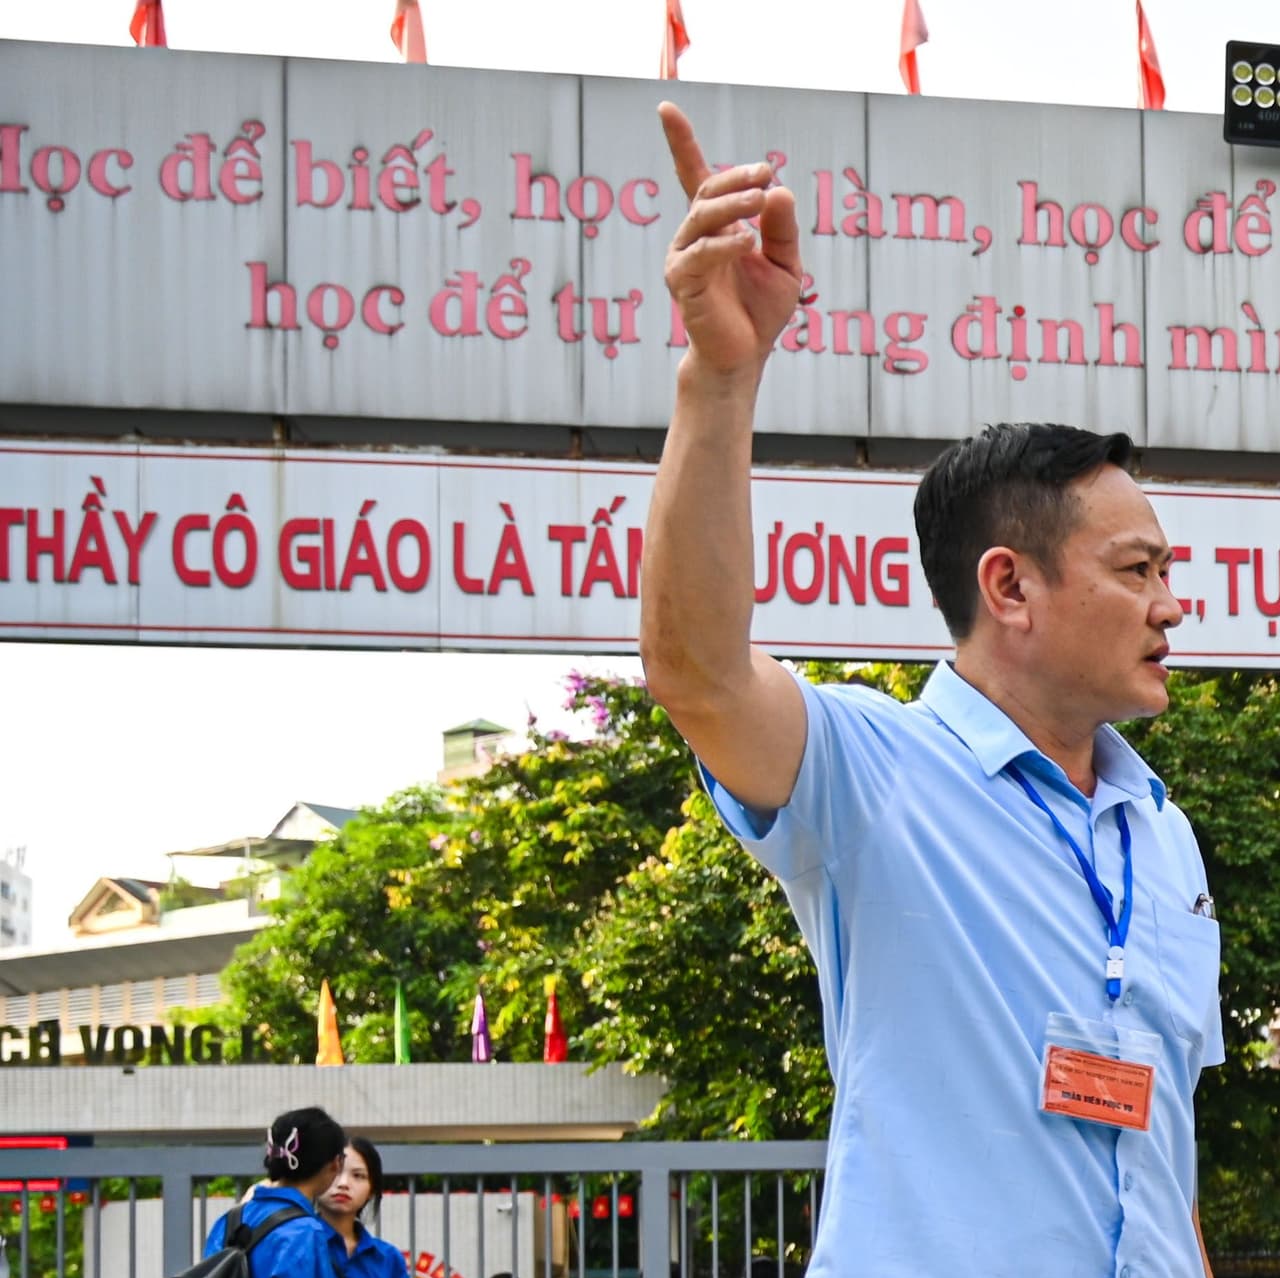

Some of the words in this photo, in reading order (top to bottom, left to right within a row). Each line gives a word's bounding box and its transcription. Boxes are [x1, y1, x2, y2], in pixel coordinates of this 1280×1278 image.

[160, 120, 265, 204] để
[292, 128, 482, 228] biết,
[511, 152, 660, 239] học
[813, 166, 993, 254] làm,
[1017, 180, 1159, 266] học
[1183, 179, 1278, 258] để
[246, 260, 405, 350] học
[428, 258, 533, 340] để
[553, 282, 644, 360] tự
[951, 294, 1145, 381] định
[0, 475, 159, 586] THẦY
[171, 492, 259, 589] CÔ
[278, 498, 433, 594] GIÁO
[452, 501, 536, 597] LÀ
[753, 520, 910, 608] ƯƠNG
